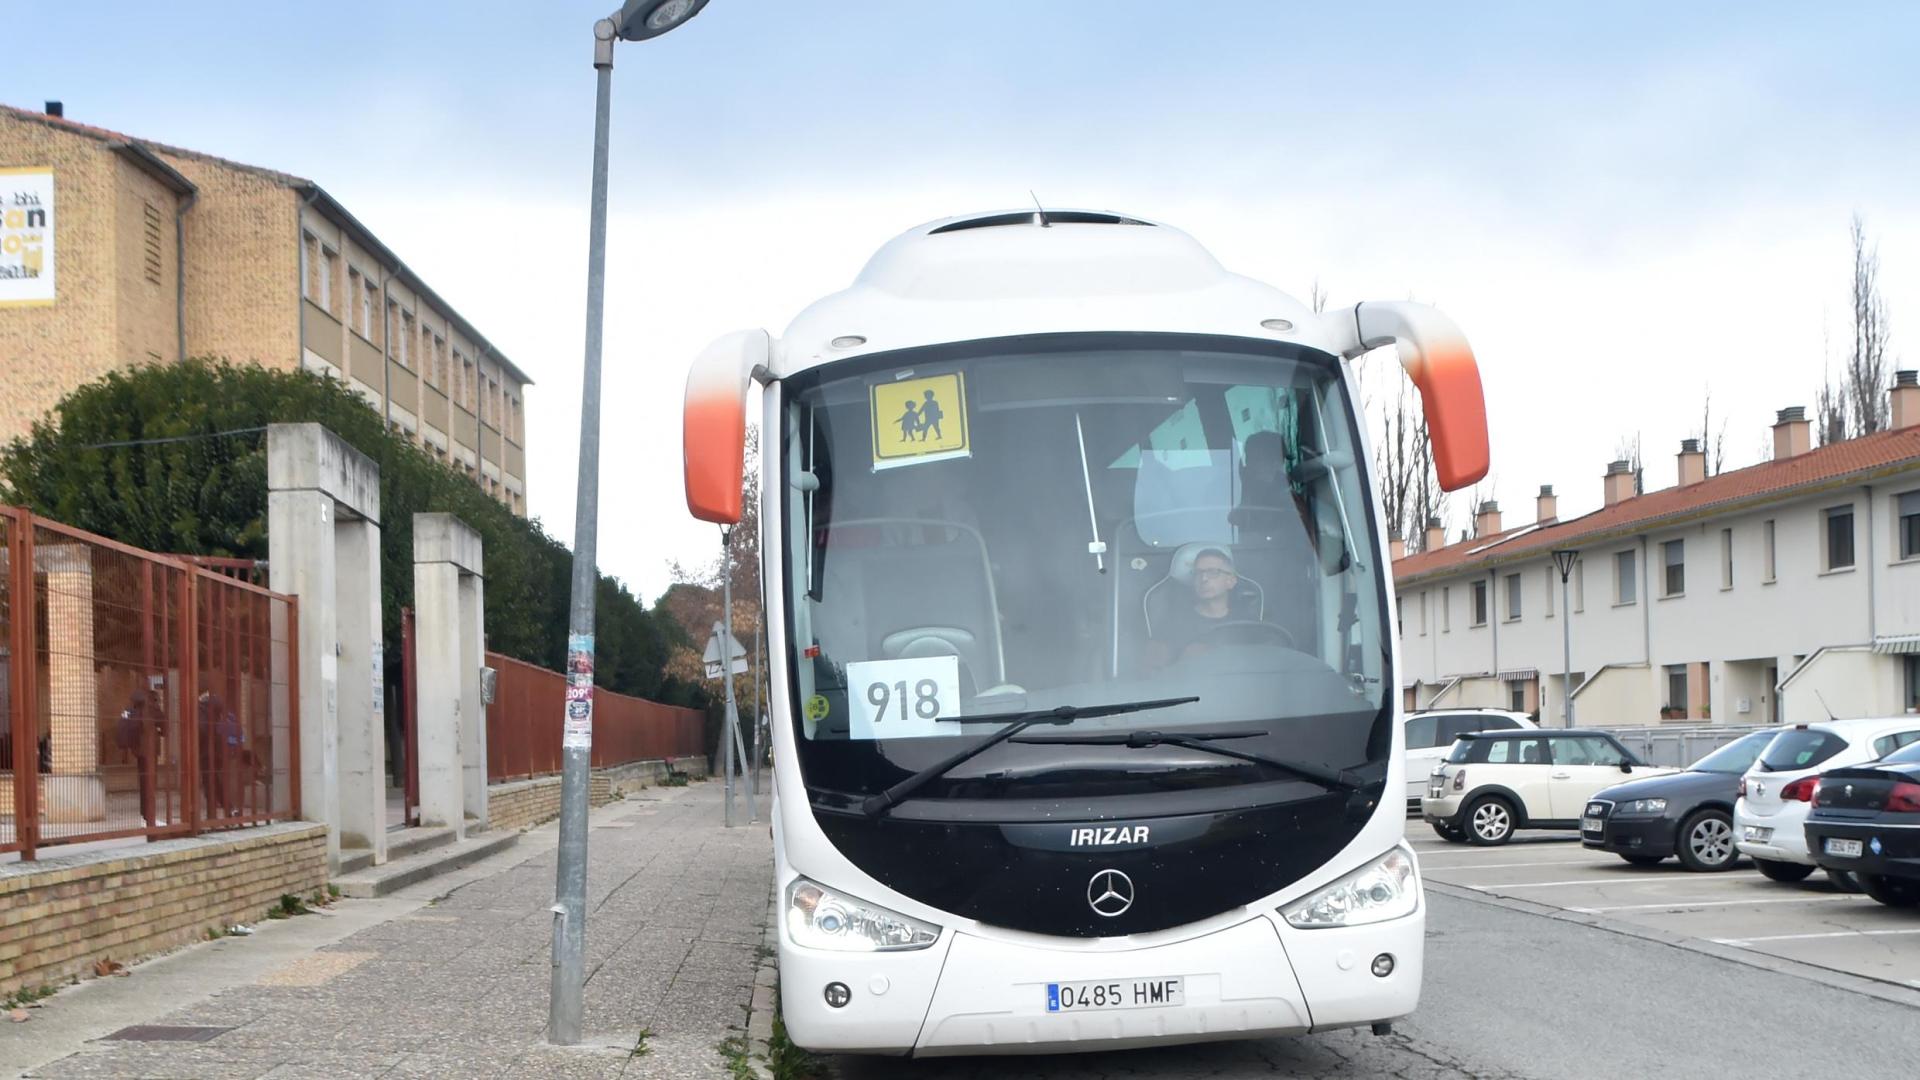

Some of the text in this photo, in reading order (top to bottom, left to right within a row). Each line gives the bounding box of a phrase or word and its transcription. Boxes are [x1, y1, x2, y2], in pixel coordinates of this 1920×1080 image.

[0, 209, 45, 228] an
[867, 678, 940, 722] 918
[1070, 826, 1150, 846] IRIZAR
[1061, 984, 1122, 1008] 0485
[1134, 980, 1178, 1004] HMF
